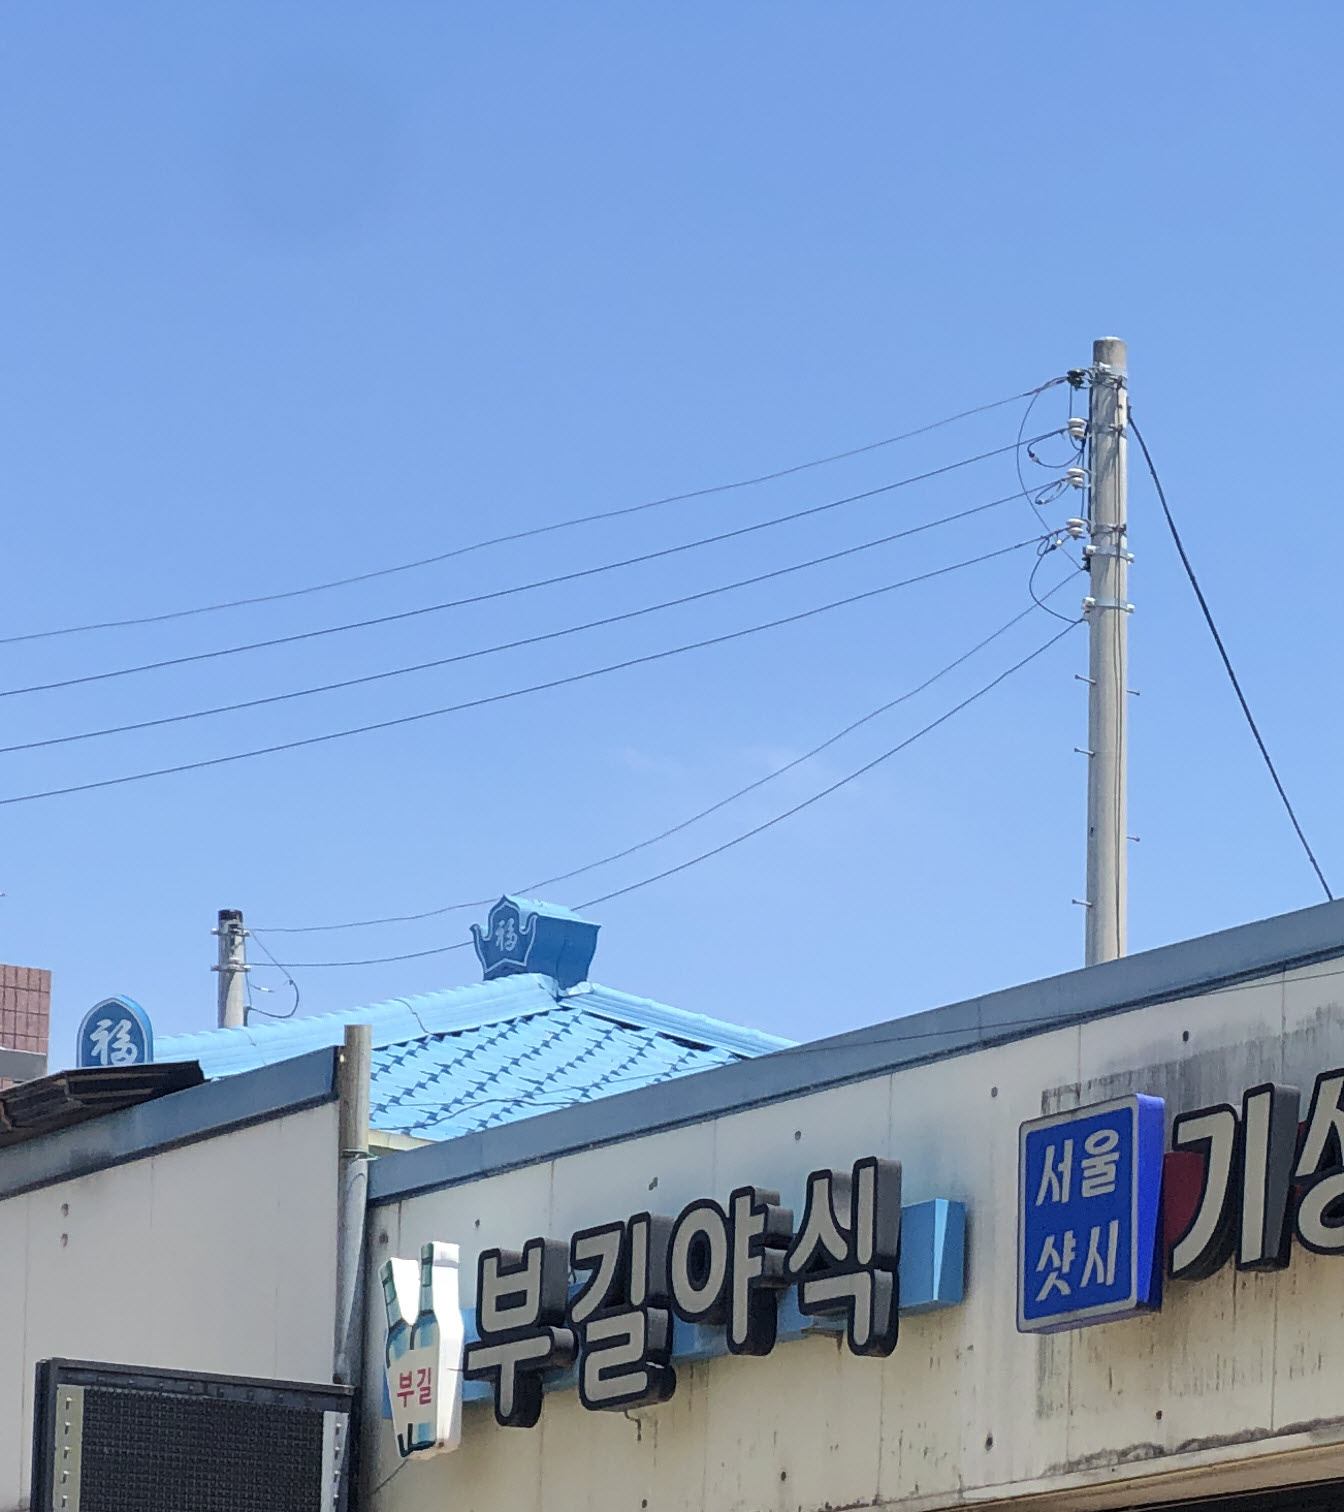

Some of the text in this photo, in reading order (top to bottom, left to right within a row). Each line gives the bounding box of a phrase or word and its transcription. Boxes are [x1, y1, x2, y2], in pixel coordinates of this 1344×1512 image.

[495, 918, 518, 952] 福
[89, 1017, 139, 1066] 福
[1035, 1129, 1120, 1206] 서울
[1035, 1219, 1120, 1301] 샷시
[464, 1156, 900, 1428] 부길야식
[396, 1367, 433, 1407] 부길
